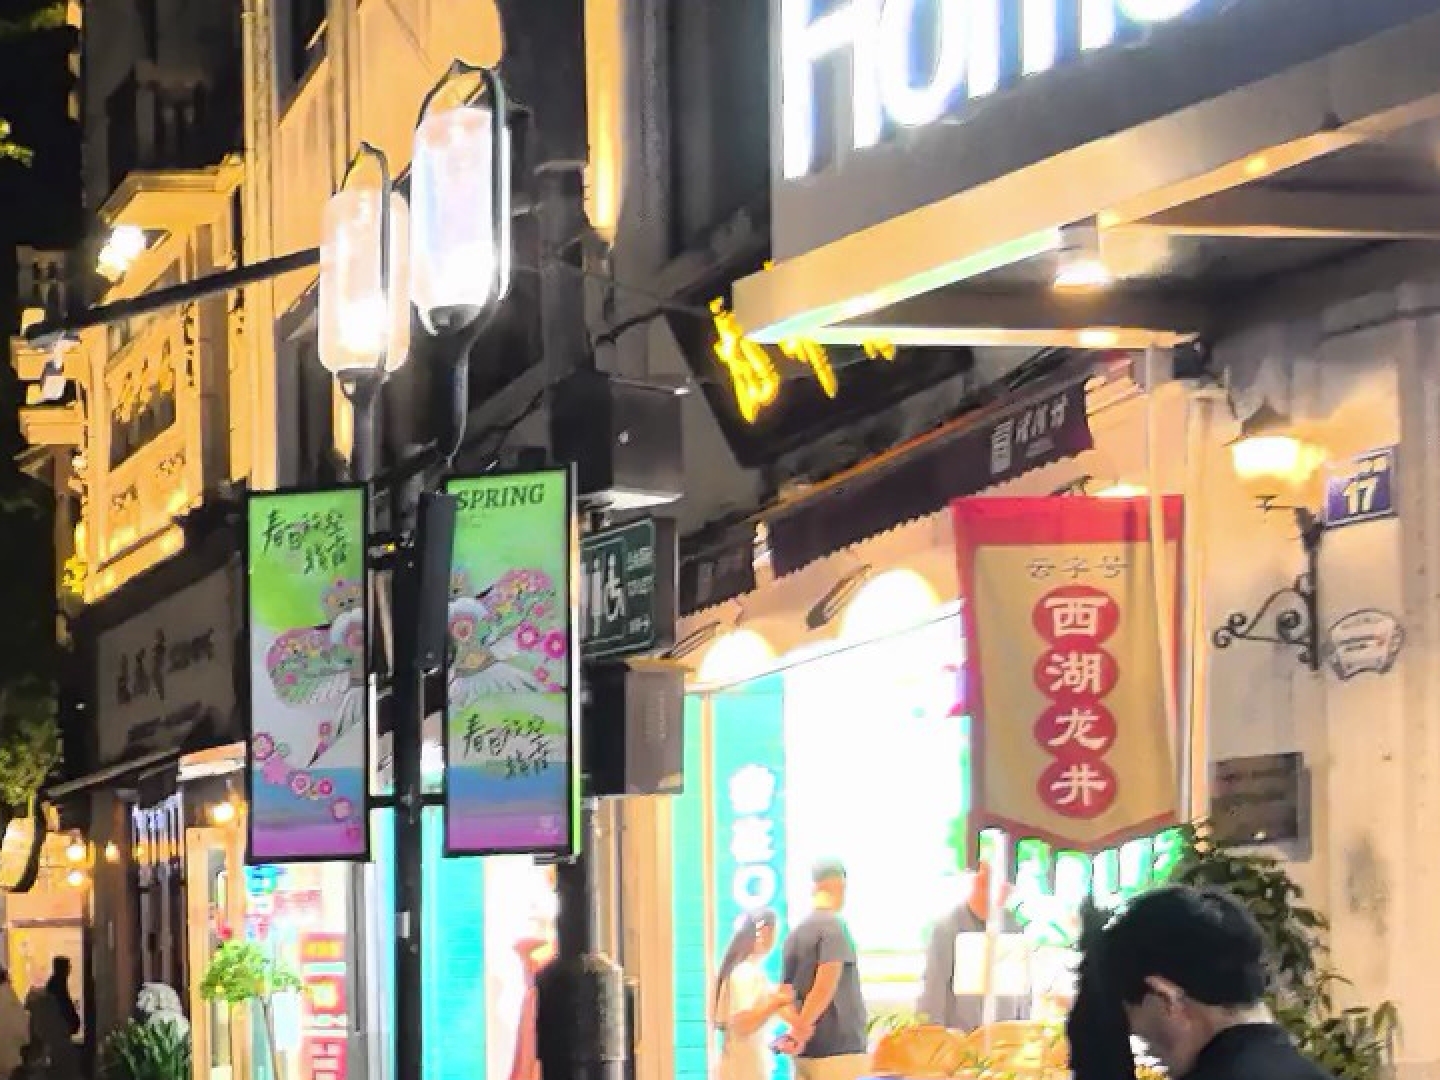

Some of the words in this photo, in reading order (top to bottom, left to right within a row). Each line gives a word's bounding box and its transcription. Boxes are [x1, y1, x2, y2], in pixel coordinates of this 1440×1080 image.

[457, 483, 544, 510] SPRING
[1342, 476, 1377, 514] 17
[1044, 596, 1109, 807] 西湖龙井
